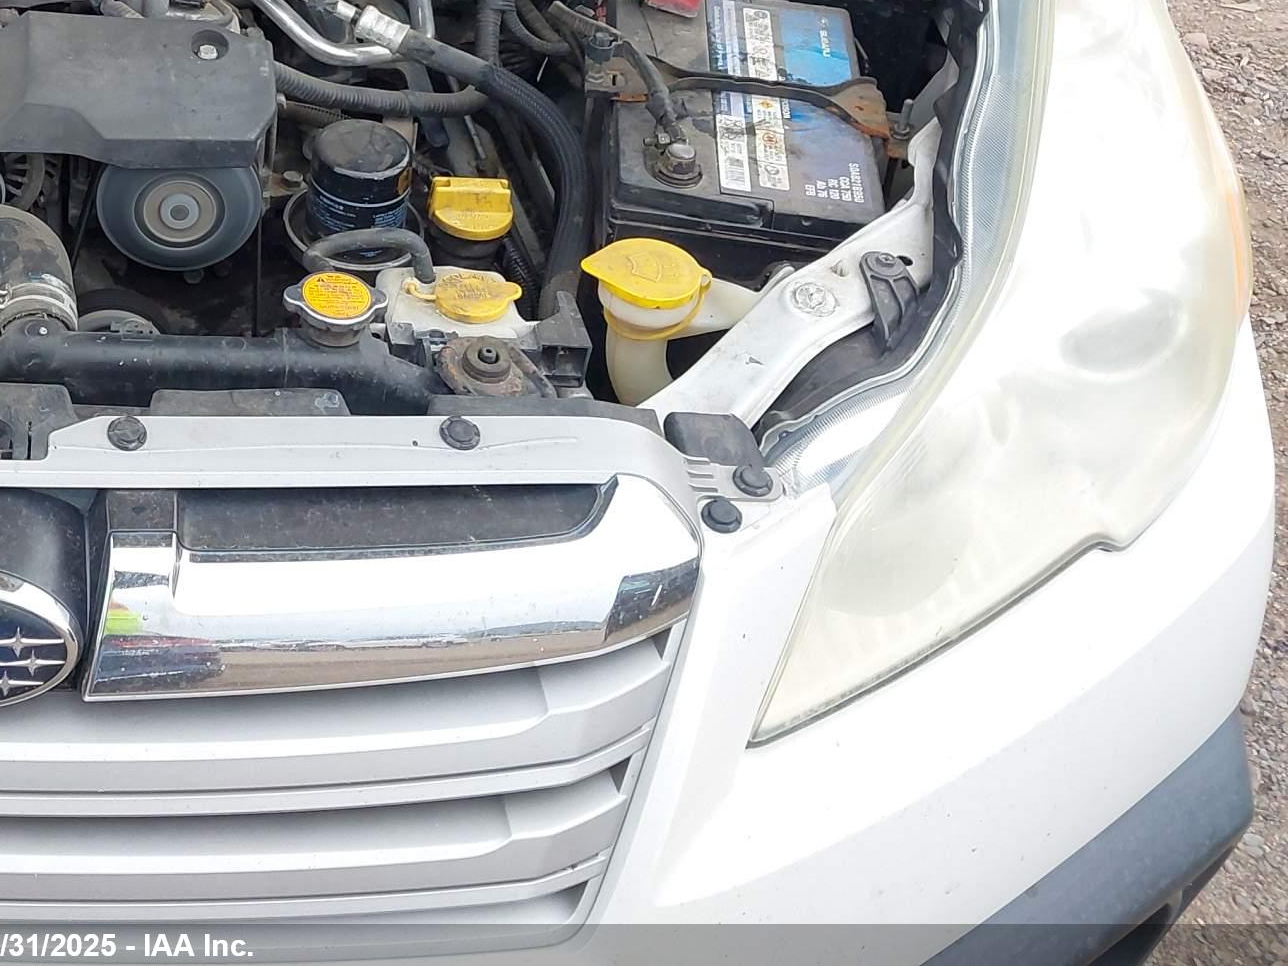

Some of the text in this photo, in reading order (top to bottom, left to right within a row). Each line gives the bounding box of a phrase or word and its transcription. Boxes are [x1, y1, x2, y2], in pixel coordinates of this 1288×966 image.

[819, 29, 831, 58] SUBARU
[804, 184, 816, 196] EFB
[839, 176, 852, 202] CCA 750
